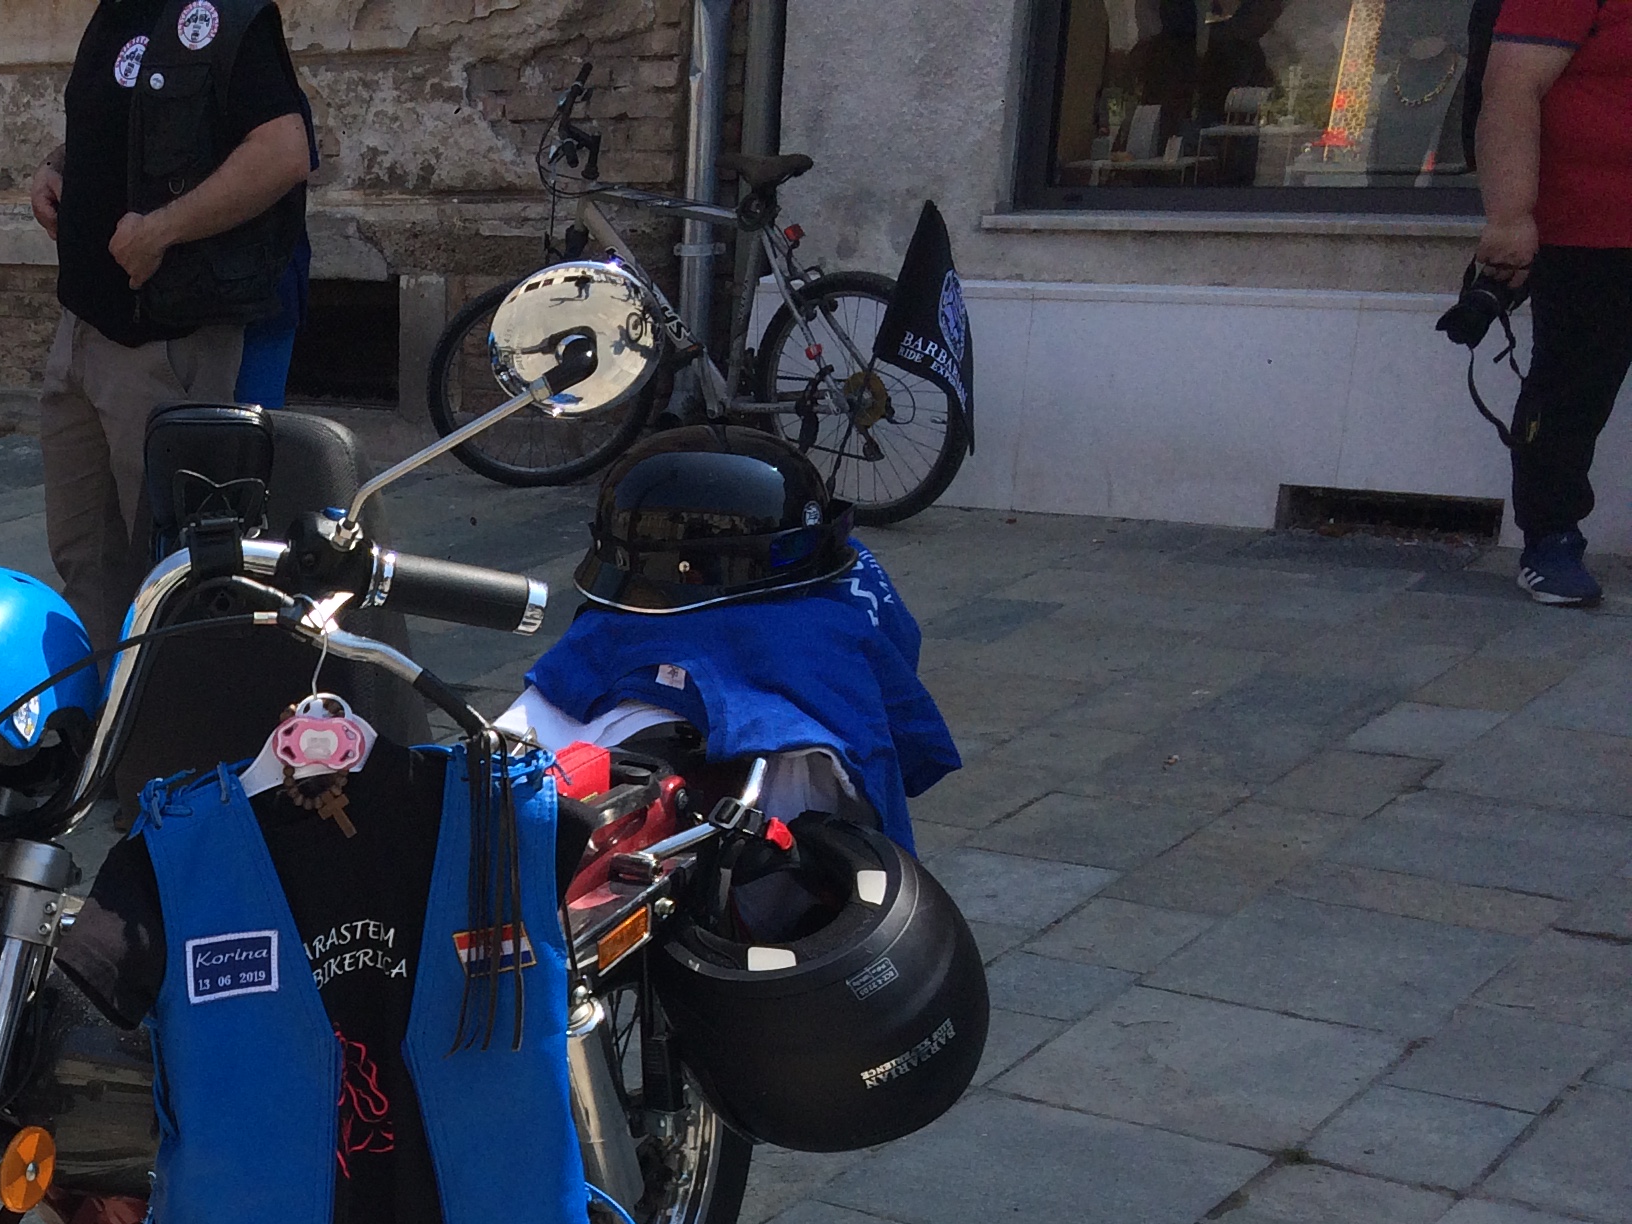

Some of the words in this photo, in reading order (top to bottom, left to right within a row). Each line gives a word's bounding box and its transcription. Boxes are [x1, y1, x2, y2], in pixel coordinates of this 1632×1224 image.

[897, 345, 925, 364] RIDE
[195, 947, 269, 969] Korina
[198, 978, 211, 991] 13
[218, 975, 232, 987] 06
[239, 970, 266, 984] 2019
